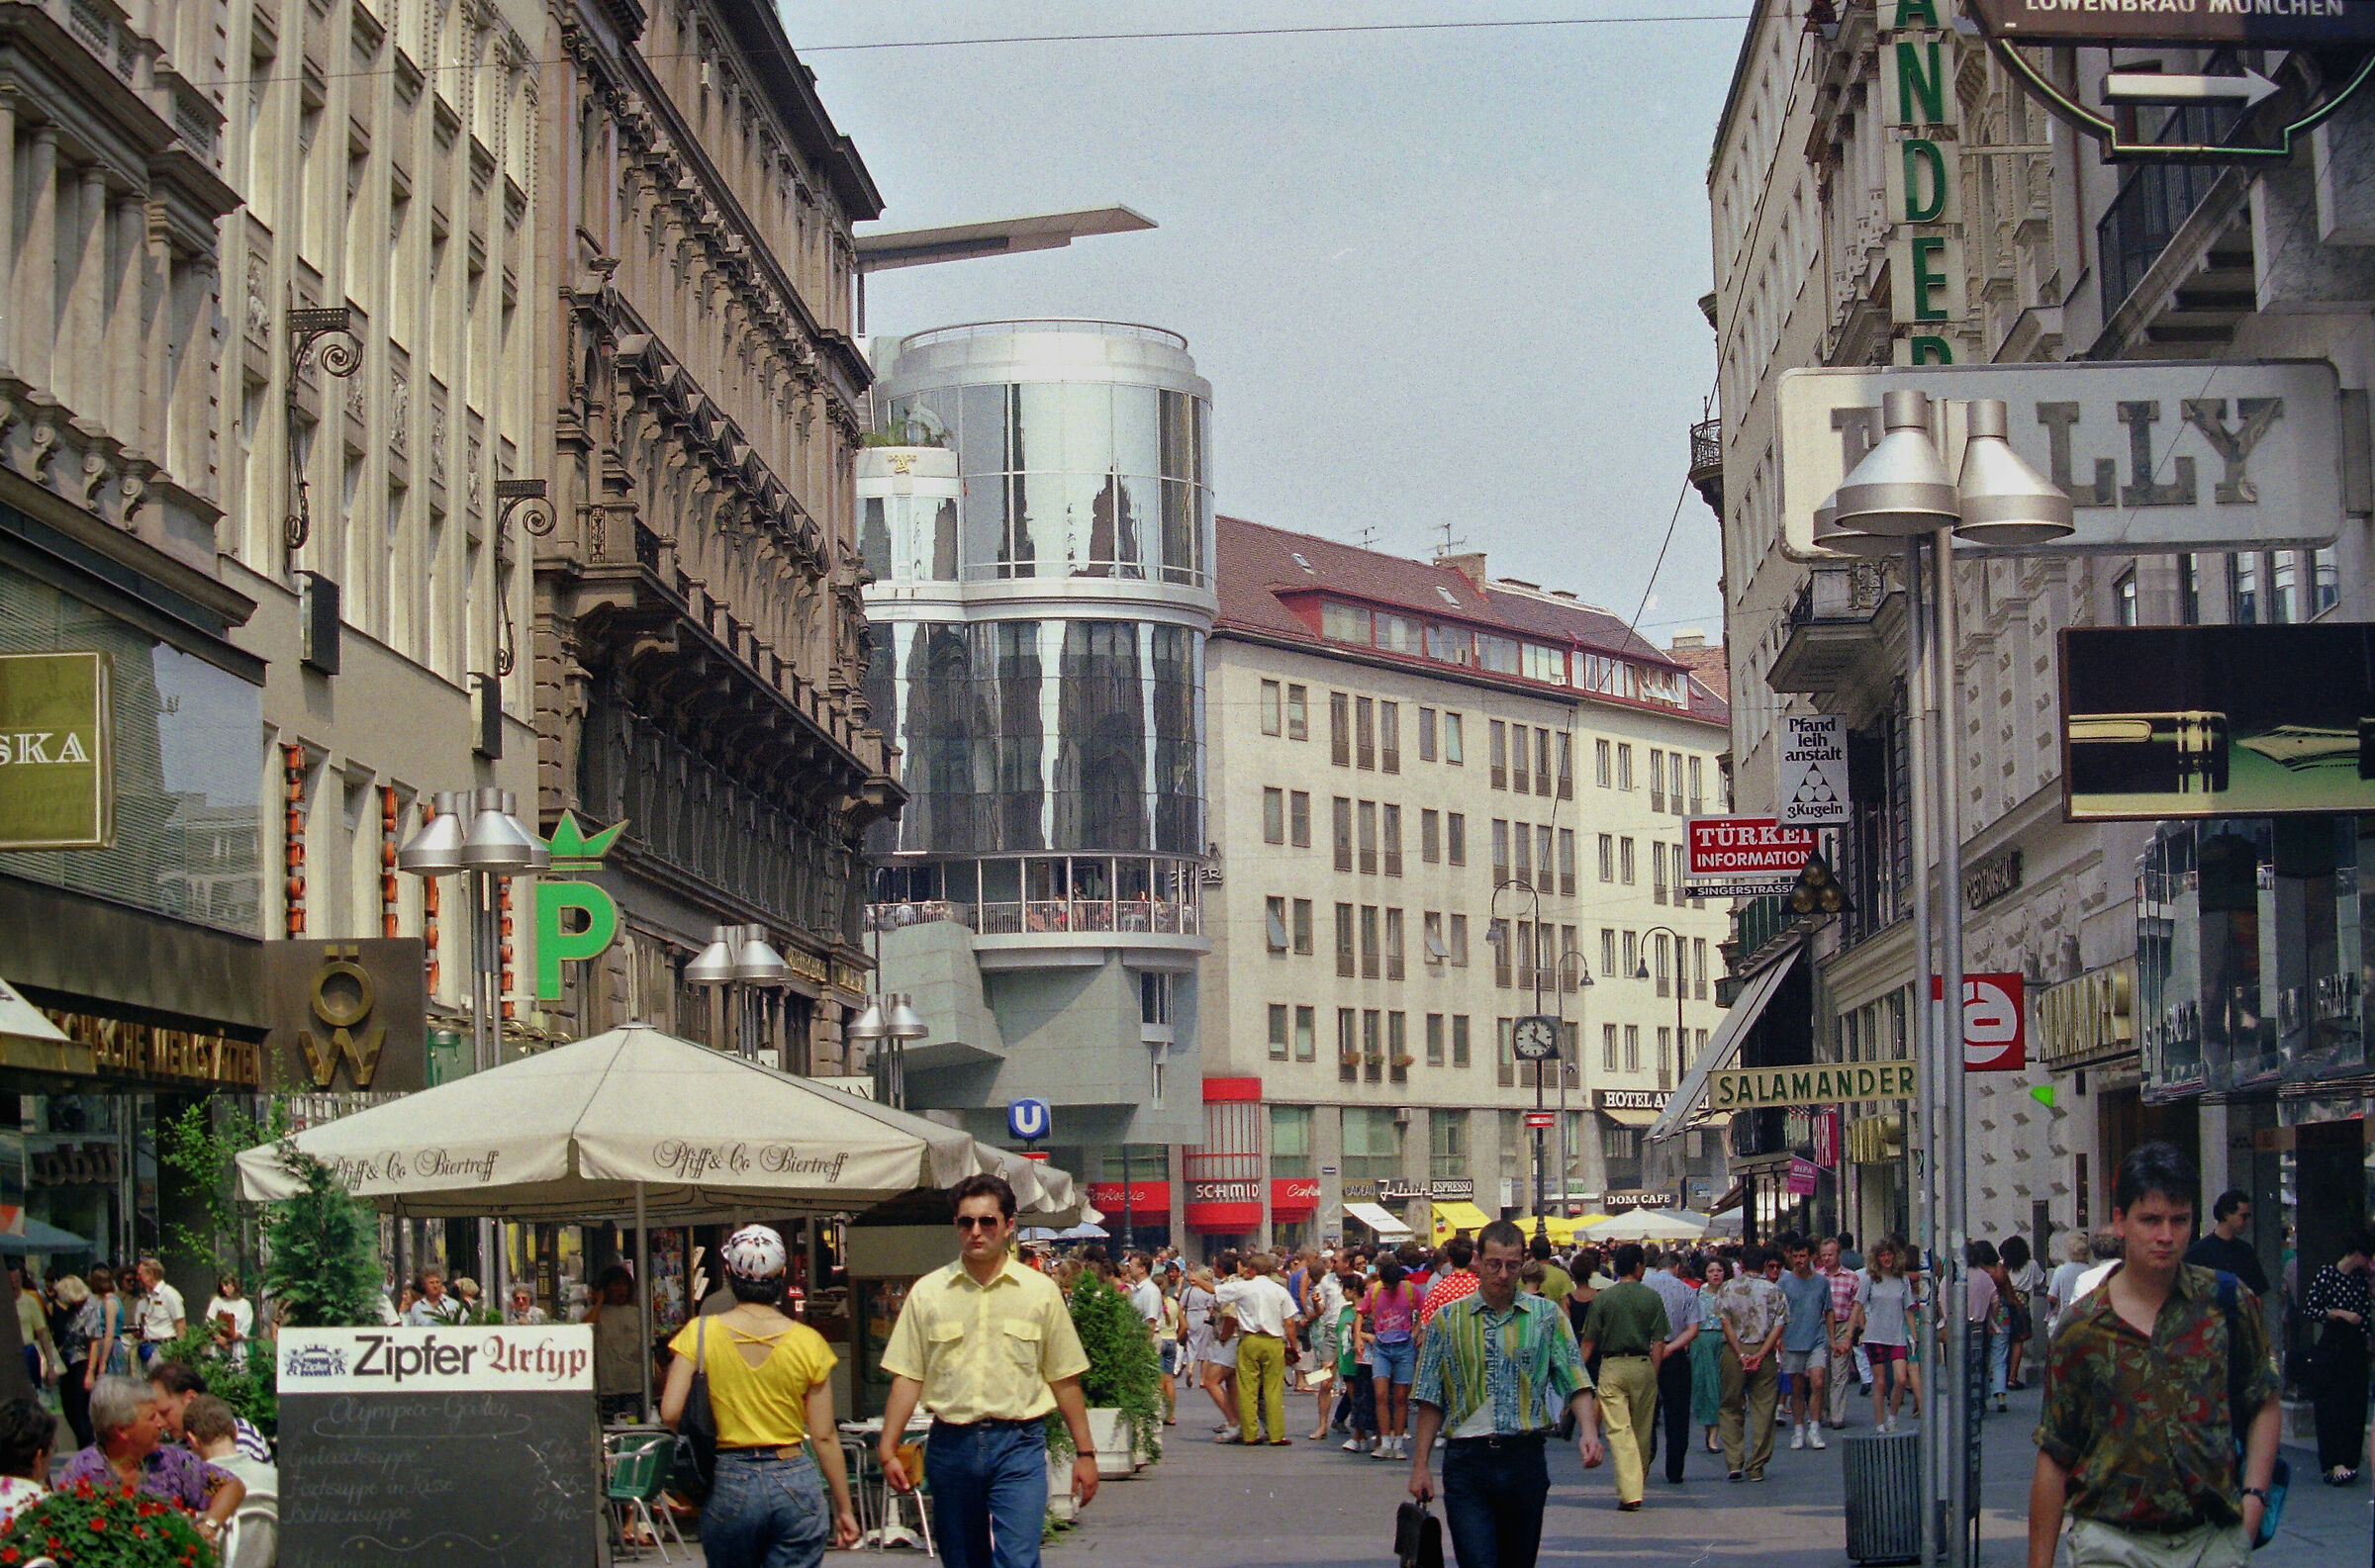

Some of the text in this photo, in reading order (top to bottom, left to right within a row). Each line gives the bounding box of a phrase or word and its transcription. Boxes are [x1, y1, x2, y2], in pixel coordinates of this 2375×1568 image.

[1831, 397, 2283, 508] LLY
[1788, 718, 1837, 733] Pfand
[1797, 733, 1828, 747] leih
[1785, 748, 1843, 762] anstalt
[1696, 823, 1813, 847] TÜRKEI
[1696, 850, 1813, 868] INFORMATION
[1718, 1065, 1915, 1104] SALAMANDER
[1604, 1091, 1653, 1108] HOTEL
[1015, 1105, 1042, 1135] U
[759, 1145, 849, 1183] Biertreff
[1195, 1184, 1262, 1199] SCHMID
[1432, 1180, 1472, 1193] ESPRESSO
[1606, 1193, 1671, 1205] DOM CAFE
[353, 1335, 478, 1383] Zipfer
